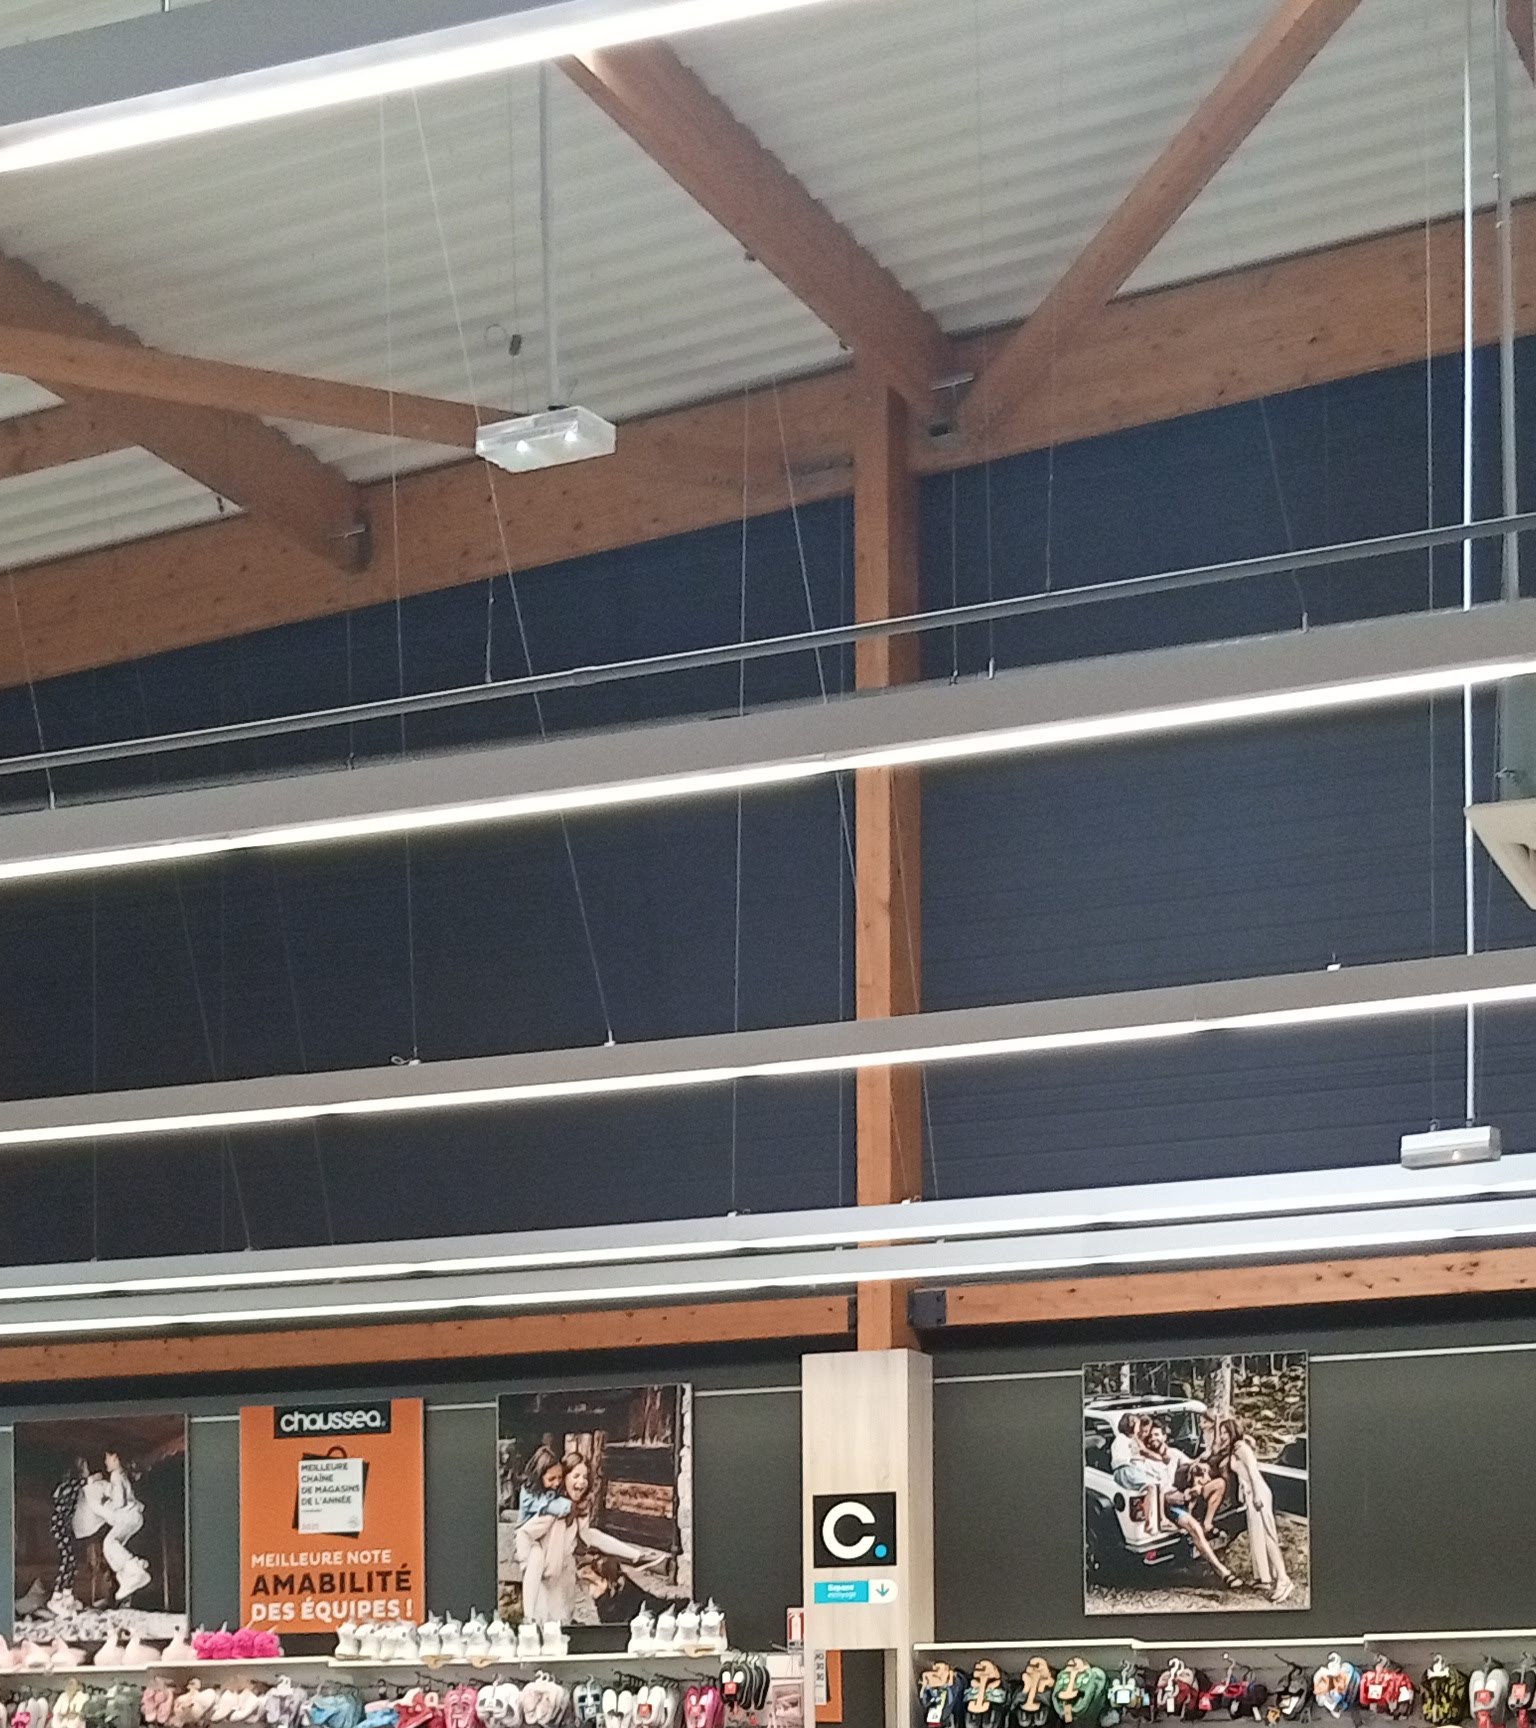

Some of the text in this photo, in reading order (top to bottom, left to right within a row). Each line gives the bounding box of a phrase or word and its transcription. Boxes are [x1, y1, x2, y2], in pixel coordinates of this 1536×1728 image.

[300, 1462, 349, 1472] MEILLEURE
[300, 1484, 361, 1495] DE MAGASINS
[300, 1497, 313, 1506] DE
[250, 1549, 393, 1569] MEILLEURE NOTE
[250, 1563, 412, 1597] AMABILITÉ
[250, 1602, 295, 1622] DES
[300, 1596, 401, 1623] ÉQUIPES
